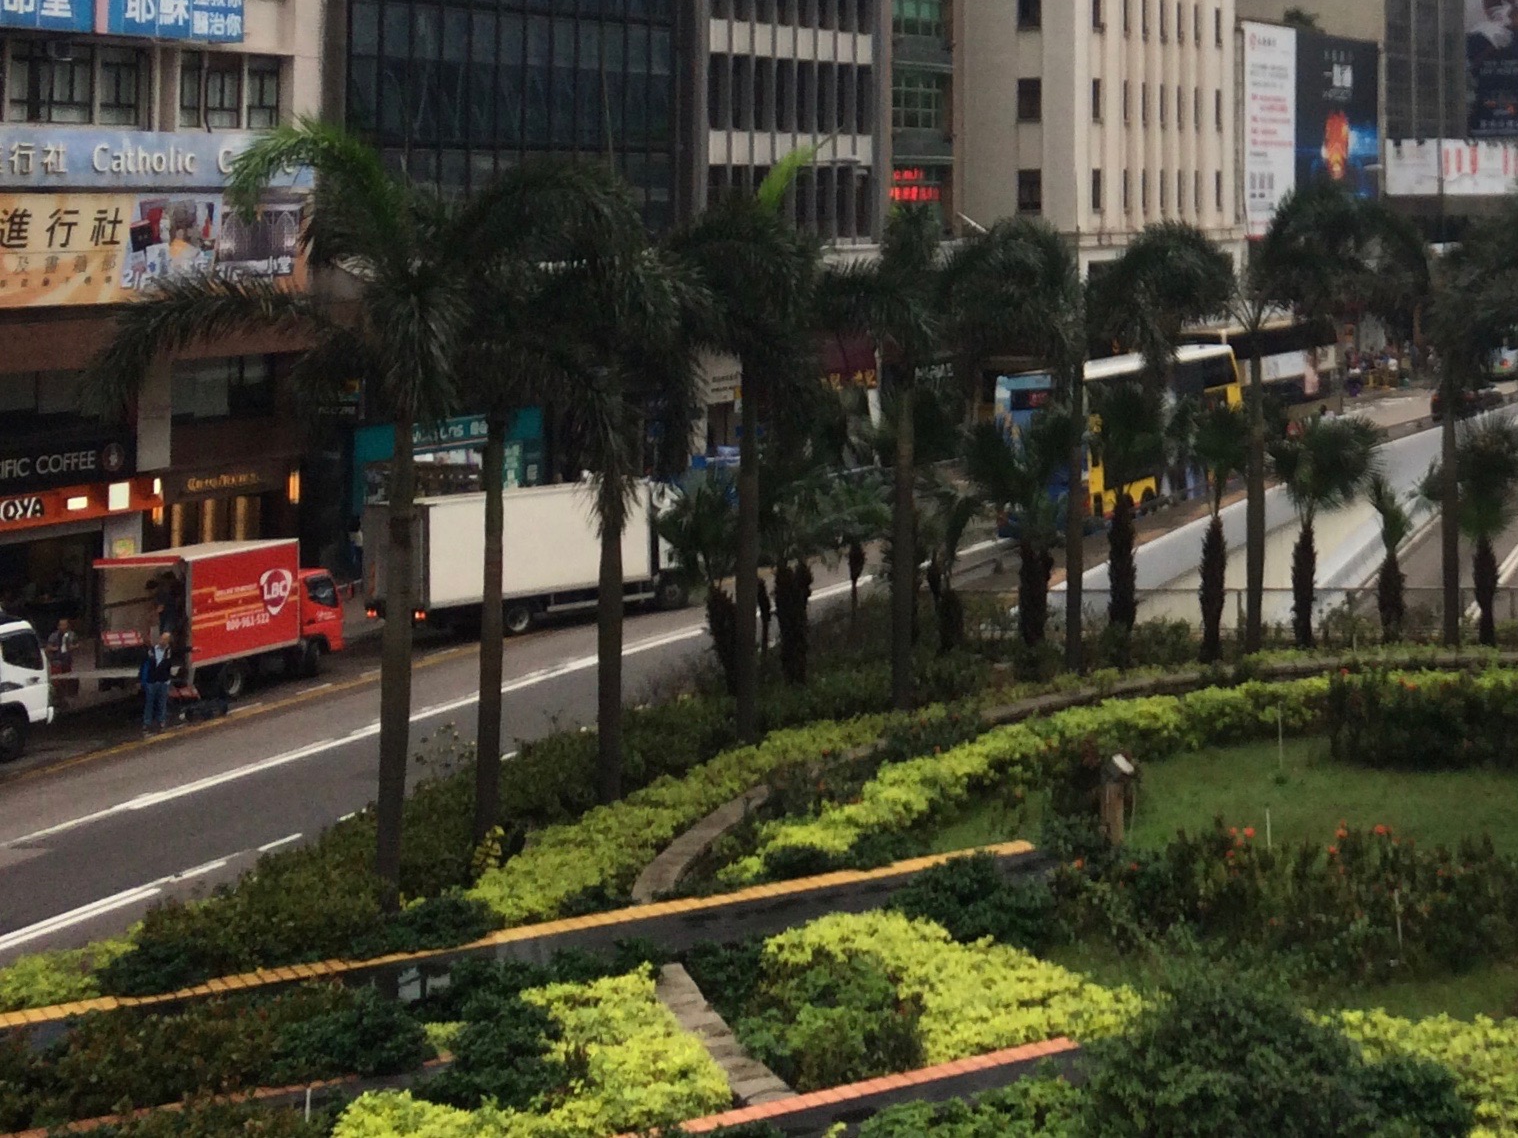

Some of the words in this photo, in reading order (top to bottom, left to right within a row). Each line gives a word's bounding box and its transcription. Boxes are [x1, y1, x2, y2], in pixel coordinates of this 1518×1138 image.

[0, 141, 68, 174] 行社
[92, 143, 196, 174] Catholic
[0, 207, 123, 248] 進行社
[36, 450, 96, 474] COFFEE
[263, 581, 288, 600] LBC
